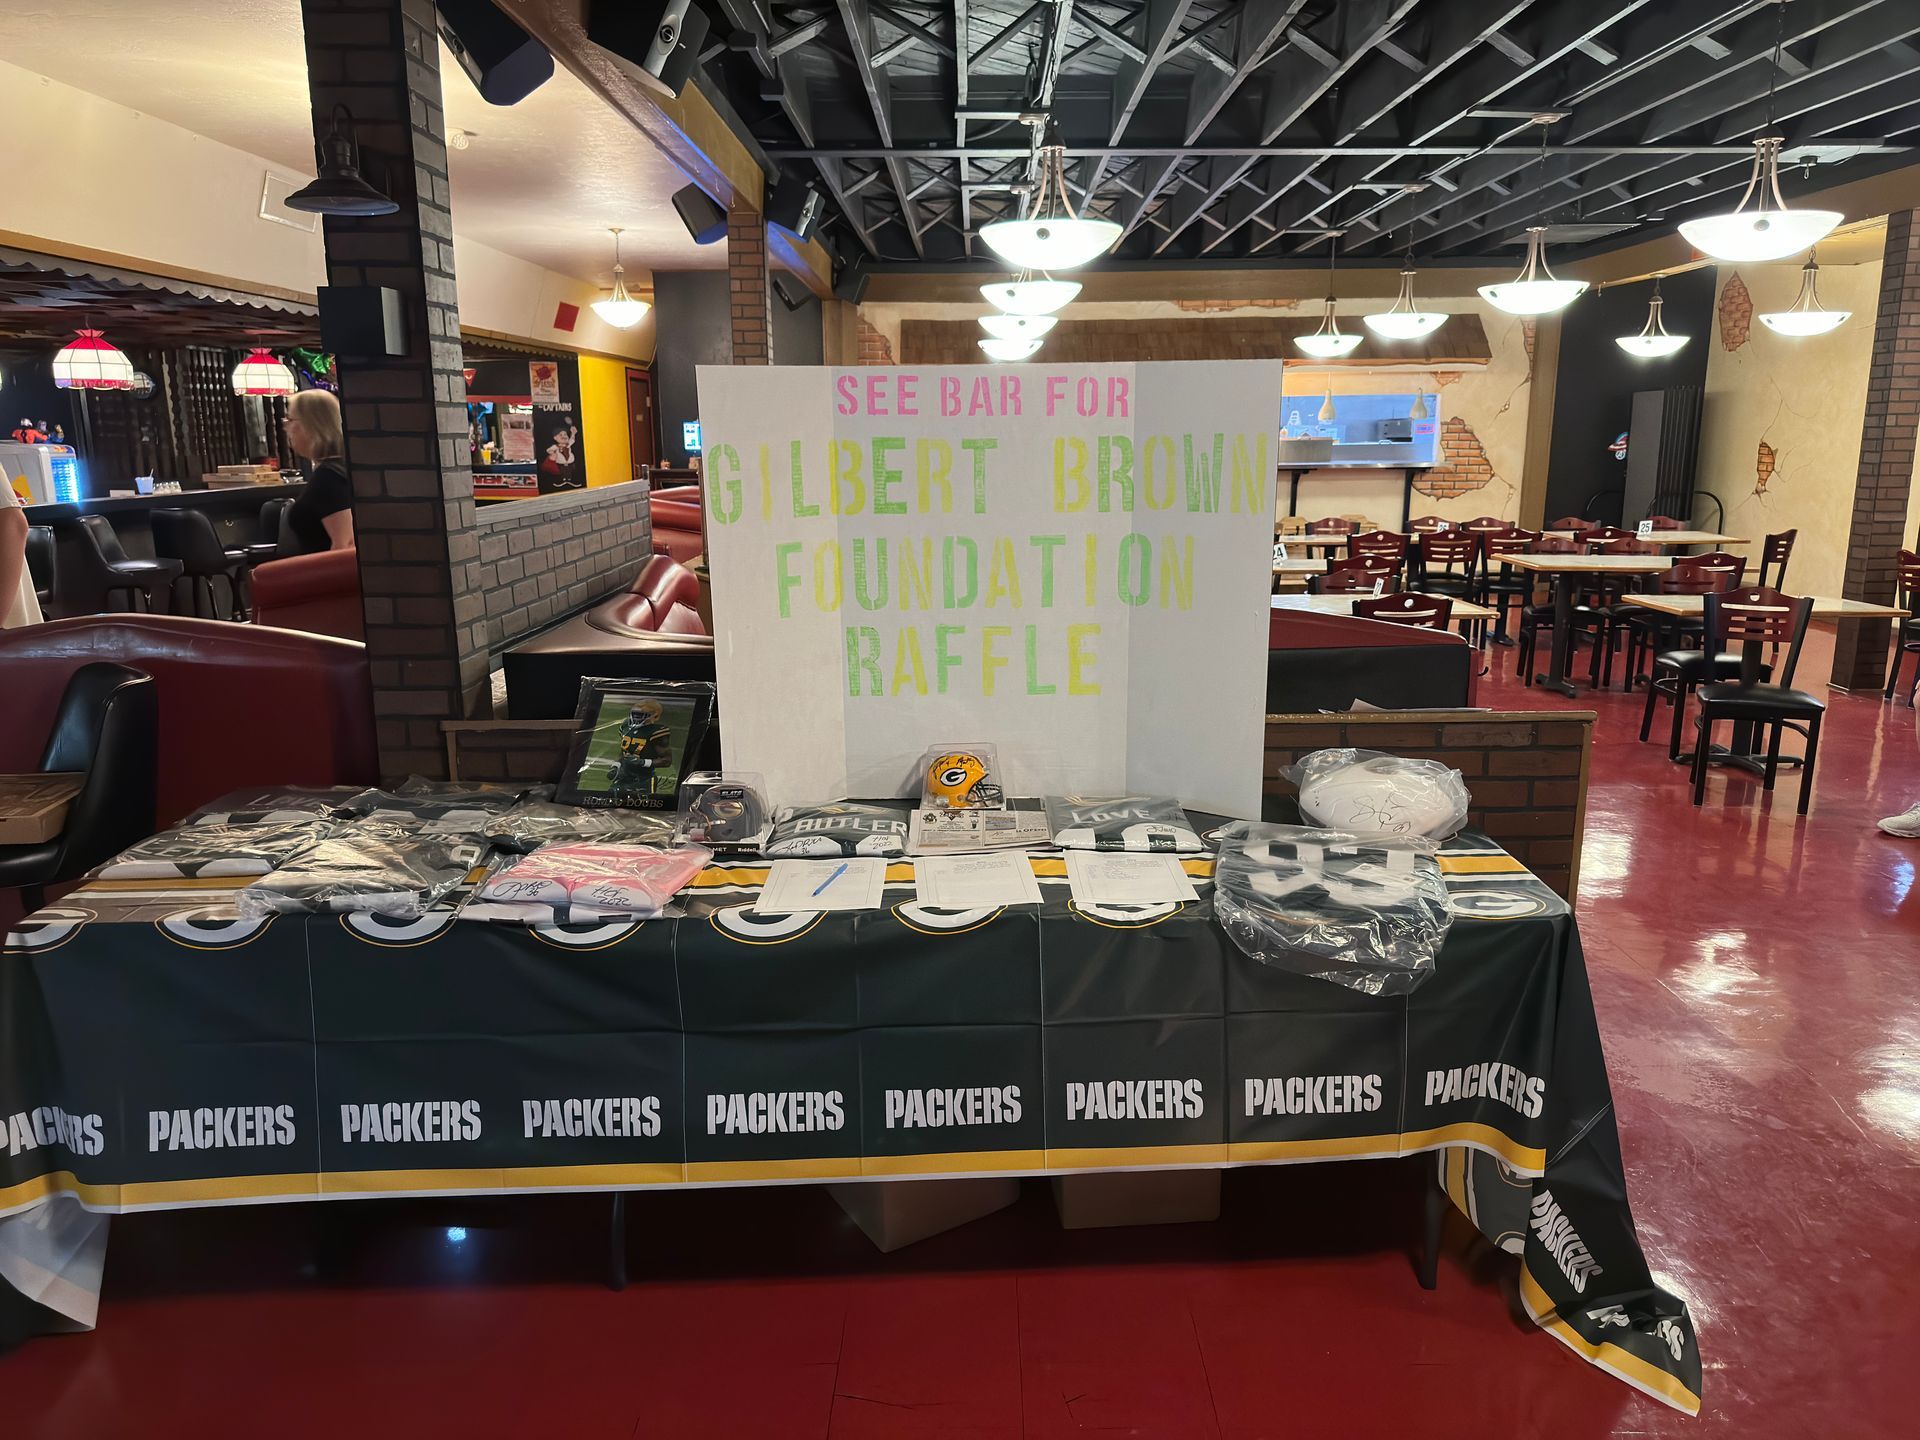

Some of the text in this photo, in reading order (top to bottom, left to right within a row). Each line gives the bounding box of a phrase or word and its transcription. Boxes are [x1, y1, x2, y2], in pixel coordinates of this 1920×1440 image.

[837, 375, 1129, 417] SEE BAR FOR
[708, 433, 1268, 525] GILBERT BROWN
[1640, 523, 1650, 532] 25
[776, 533, 1194, 618] FOUNDATION
[846, 624, 1102, 697] RAFFLE
[626, 798, 664, 809] DOUBS
[1071, 807, 1156, 824] LOVE
[794, 817, 907, 839] BUTLER
[885, 1085, 1022, 1129] PACKERS
[1066, 1079, 1204, 1121] PACKERS
[1244, 1074, 1382, 1117] PACKERS
[1425, 1062, 1546, 1119] PACKERS
[150, 1104, 296, 1151] PACKERS
[341, 1099, 482, 1143] PACKERS
[523, 1096, 661, 1138] PACKERS
[707, 1090, 845, 1135] PACKERS
